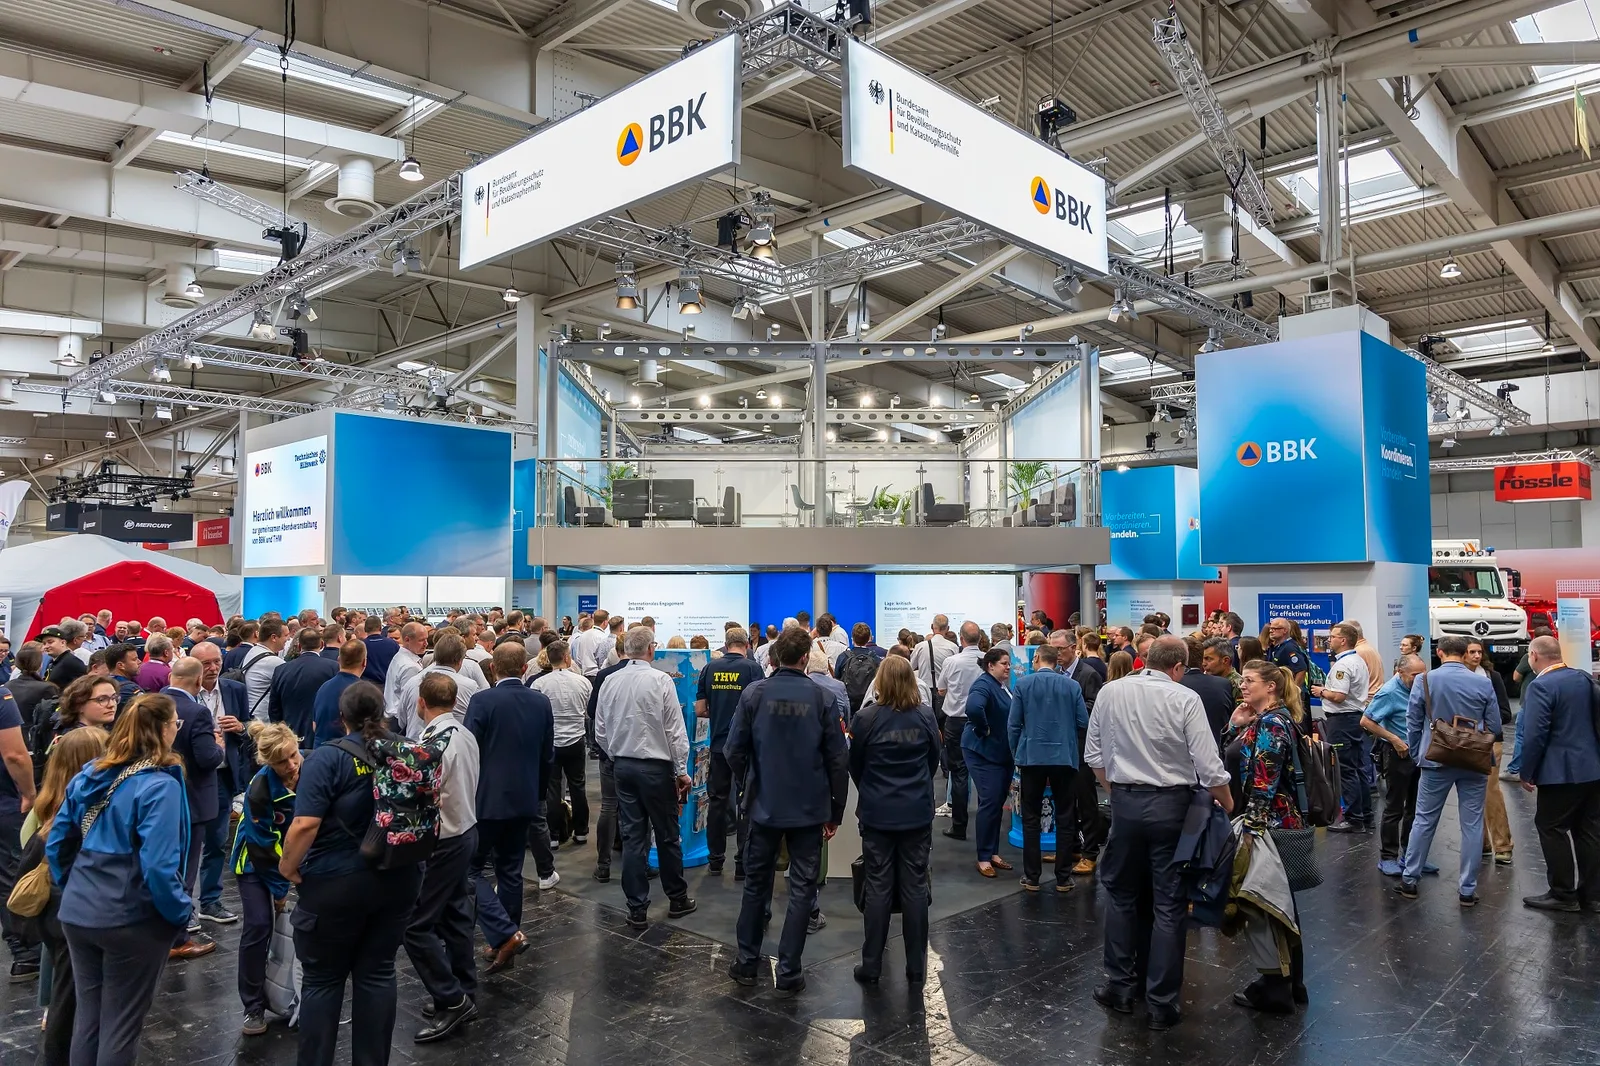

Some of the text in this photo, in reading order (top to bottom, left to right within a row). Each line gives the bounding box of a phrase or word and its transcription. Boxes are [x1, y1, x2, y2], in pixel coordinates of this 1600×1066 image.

[896, 92, 930, 118] Bundesamt
[649, 92, 707, 153] BBK
[896, 105, 962, 147] für Bevölkerungsschutz
[896, 120, 960, 157] und Katastrophenhilfe
[492, 170, 517, 188] Bundesamt
[499, 169, 544, 195] Bevölkerungsschutz
[491, 180, 542, 210] und Katastrophenhilfe
[1055, 188, 1093, 235] BBK
[1266, 437, 1318, 463] BBK
[1380, 443, 1414, 468] Koordinieren.
[260, 461, 273, 475] BBK
[1500, 473, 1573, 490] rössle
[252, 506, 312, 522] Herzlich willkommen
[1104, 511, 1147, 521] Vorbereiten.
[135, 522, 173, 530] MERCURY
[1110, 530, 1139, 539] andeln.
[713, 672, 740, 682] THW
[767, 700, 811, 717] THW
